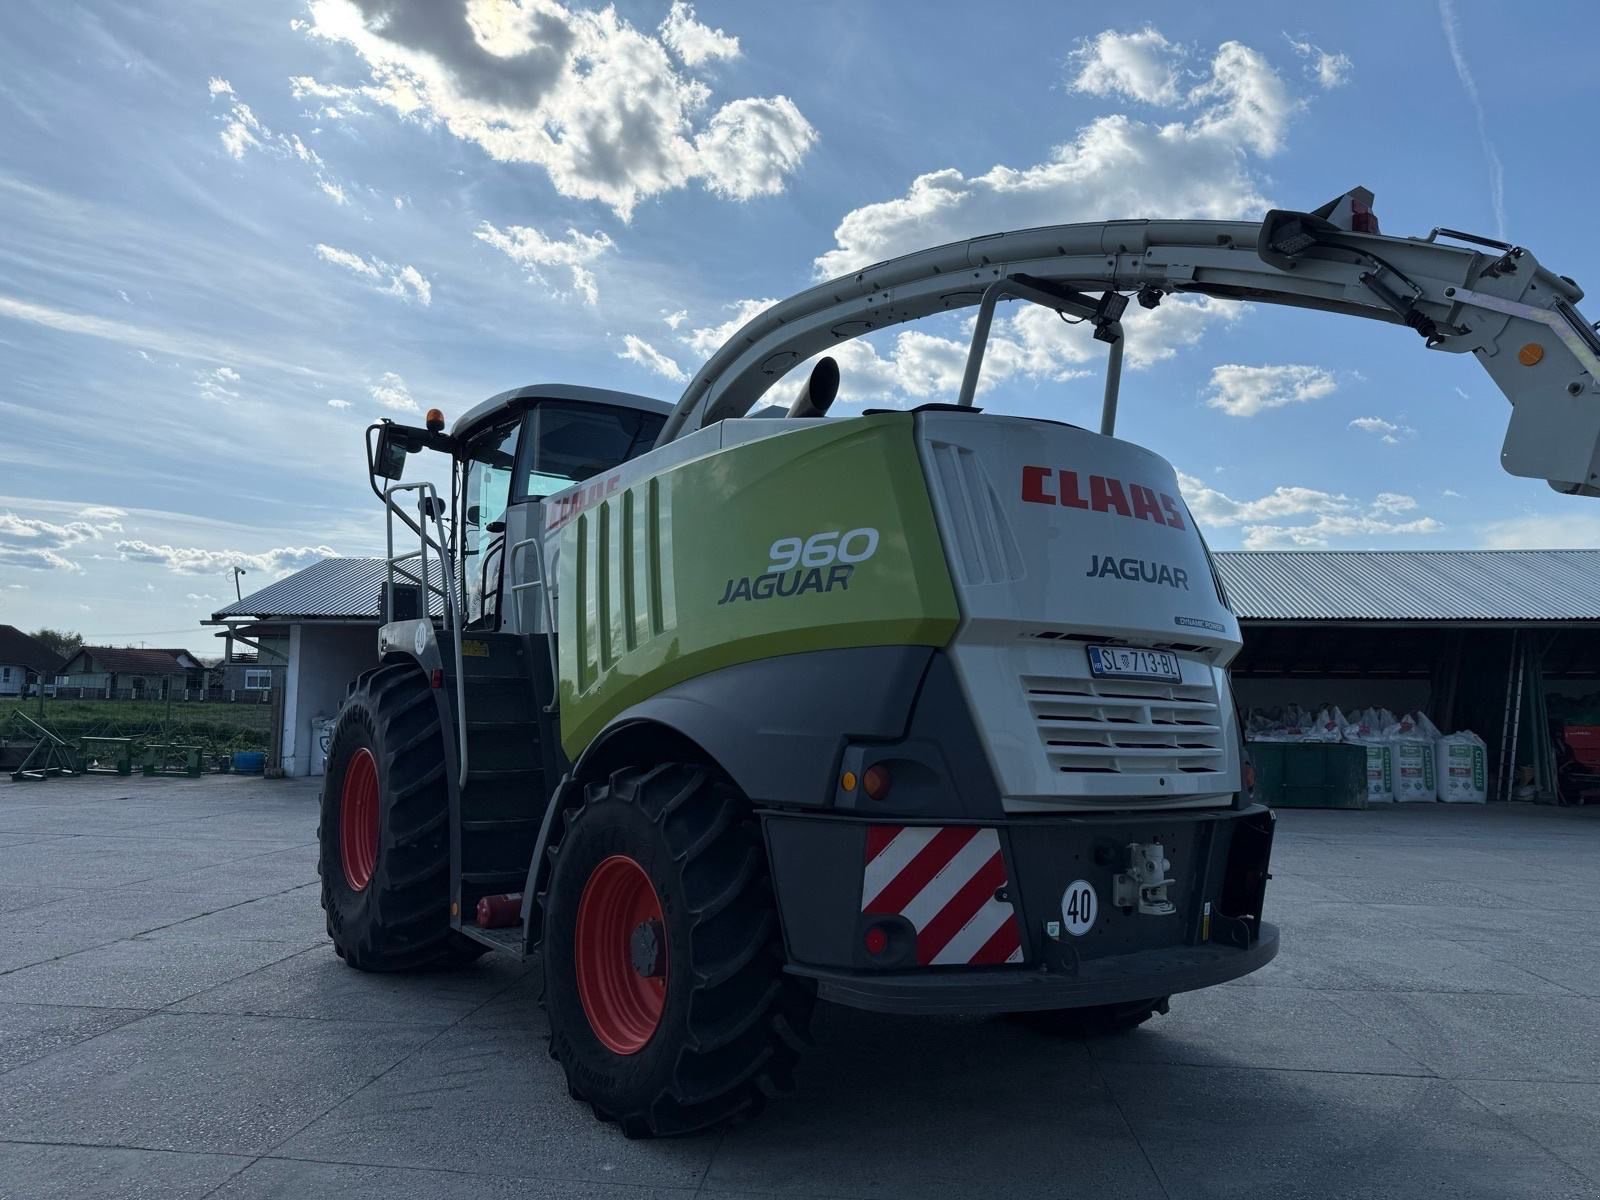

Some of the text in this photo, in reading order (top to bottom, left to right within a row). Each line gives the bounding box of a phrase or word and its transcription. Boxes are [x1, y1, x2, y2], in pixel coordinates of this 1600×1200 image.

[1021, 465, 1186, 531] CLAAS
[767, 527, 880, 573] 960
[717, 564, 855, 605] JAGUAR
[1086, 555, 1189, 591] JAGUAR
[1101, 649, 1121, 671] SL
[1066, 888, 1091, 924] 40
